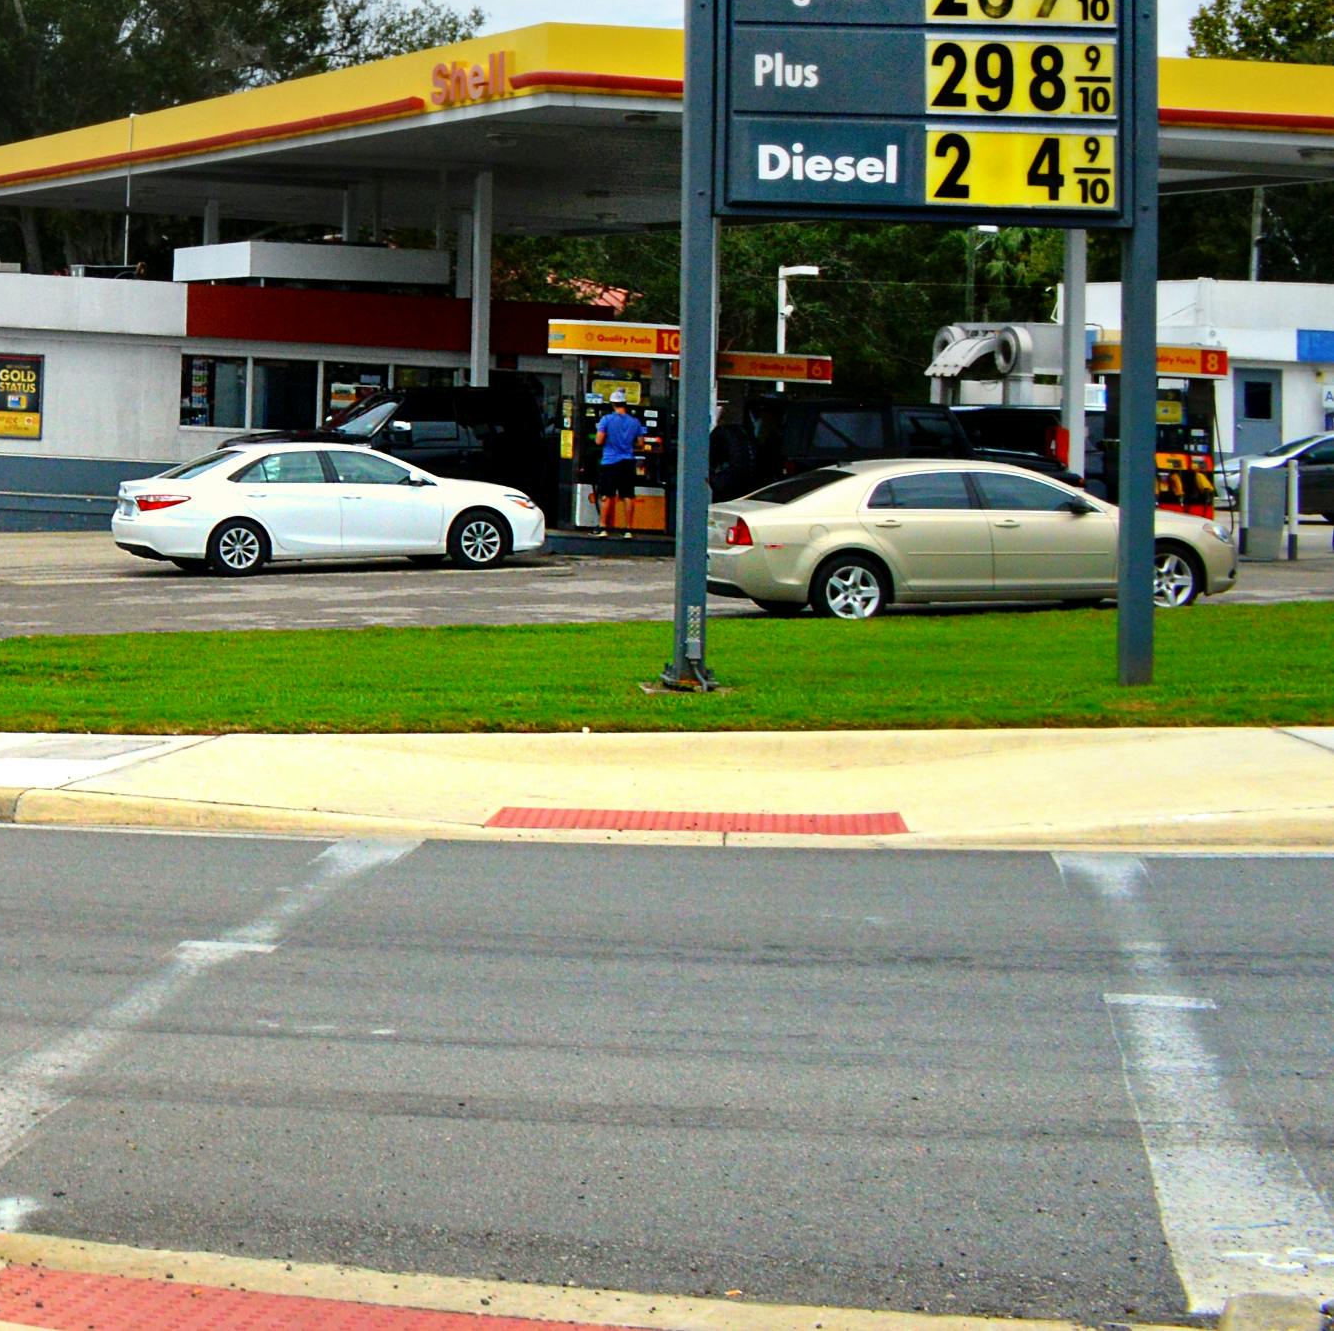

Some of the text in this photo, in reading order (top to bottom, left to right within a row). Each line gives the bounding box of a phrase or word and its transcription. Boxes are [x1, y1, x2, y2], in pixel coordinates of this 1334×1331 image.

[430, 50, 506, 106] Shell
[754, 53, 819, 88] Plus
[757, 143, 898, 184] Diesel
[596, 334, 629, 346] Quality
[630, 335, 652, 345] Fuels
[811, 360, 822, 377] 6
[1207, 352, 1219, 372] 8
[0, 369, 37, 383] GOLD
[0, 382, 37, 393] STATUS
